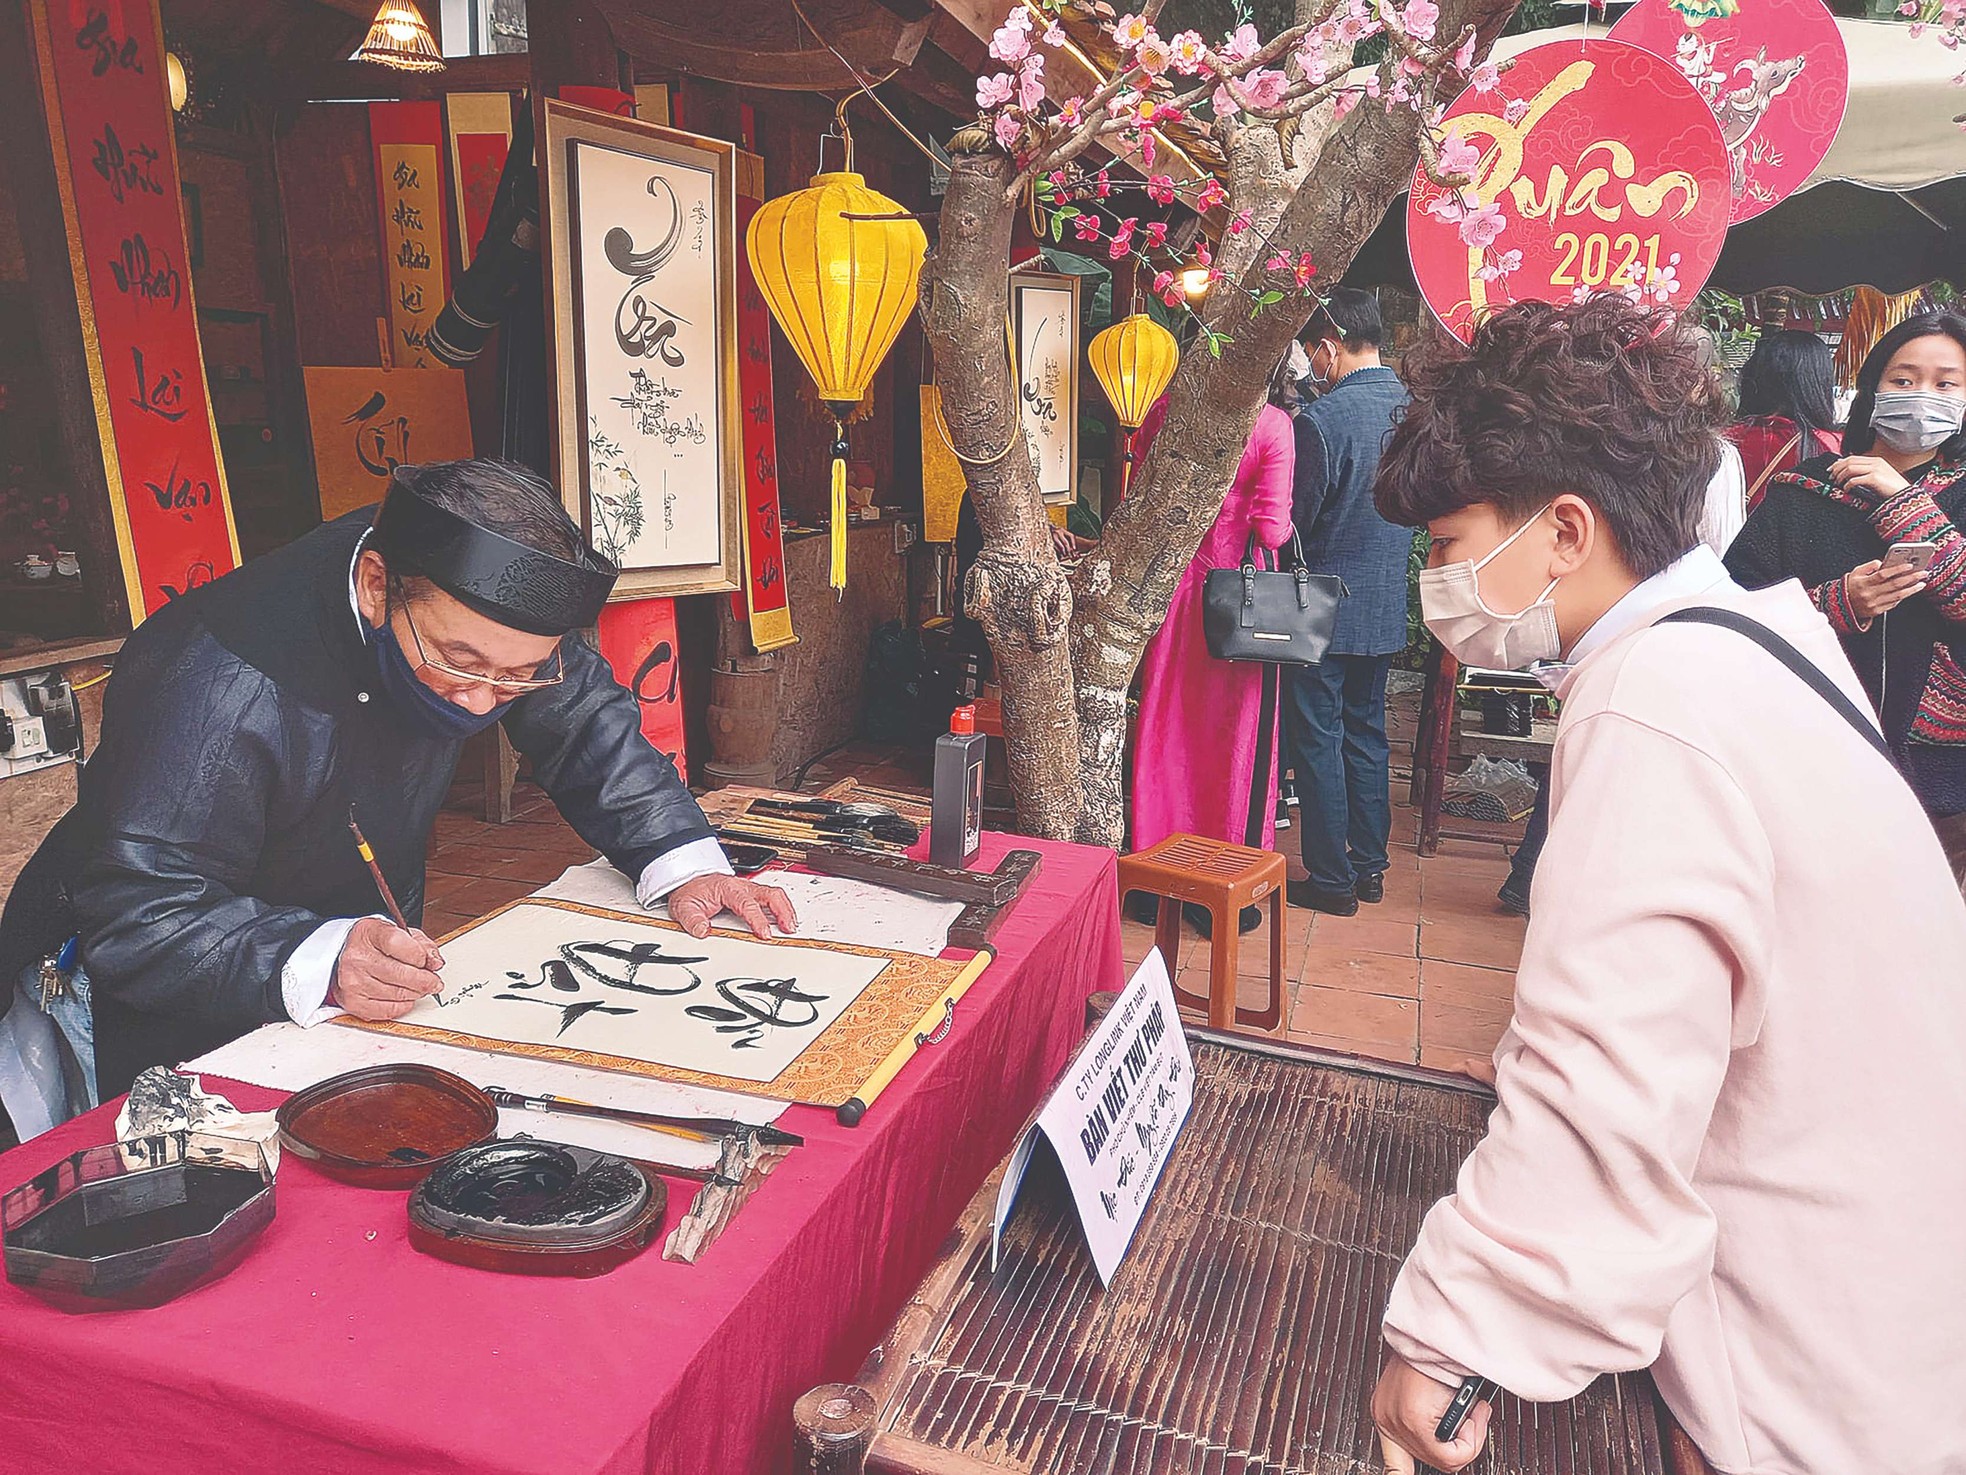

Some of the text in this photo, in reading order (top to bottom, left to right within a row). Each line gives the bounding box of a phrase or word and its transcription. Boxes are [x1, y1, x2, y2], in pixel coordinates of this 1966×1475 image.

[1431, 59, 1700, 327] Xuân
[1550, 232, 1661, 287] 2021
[129, 346, 189, 422] Lai
[144, 452, 212, 522] Vạn
[1075, 983, 1148, 1101] C.TY LONGLINK VIỆT NAM
[1080, 1000, 1166, 1167] BÀN VIẾT THƯ PHÁP
